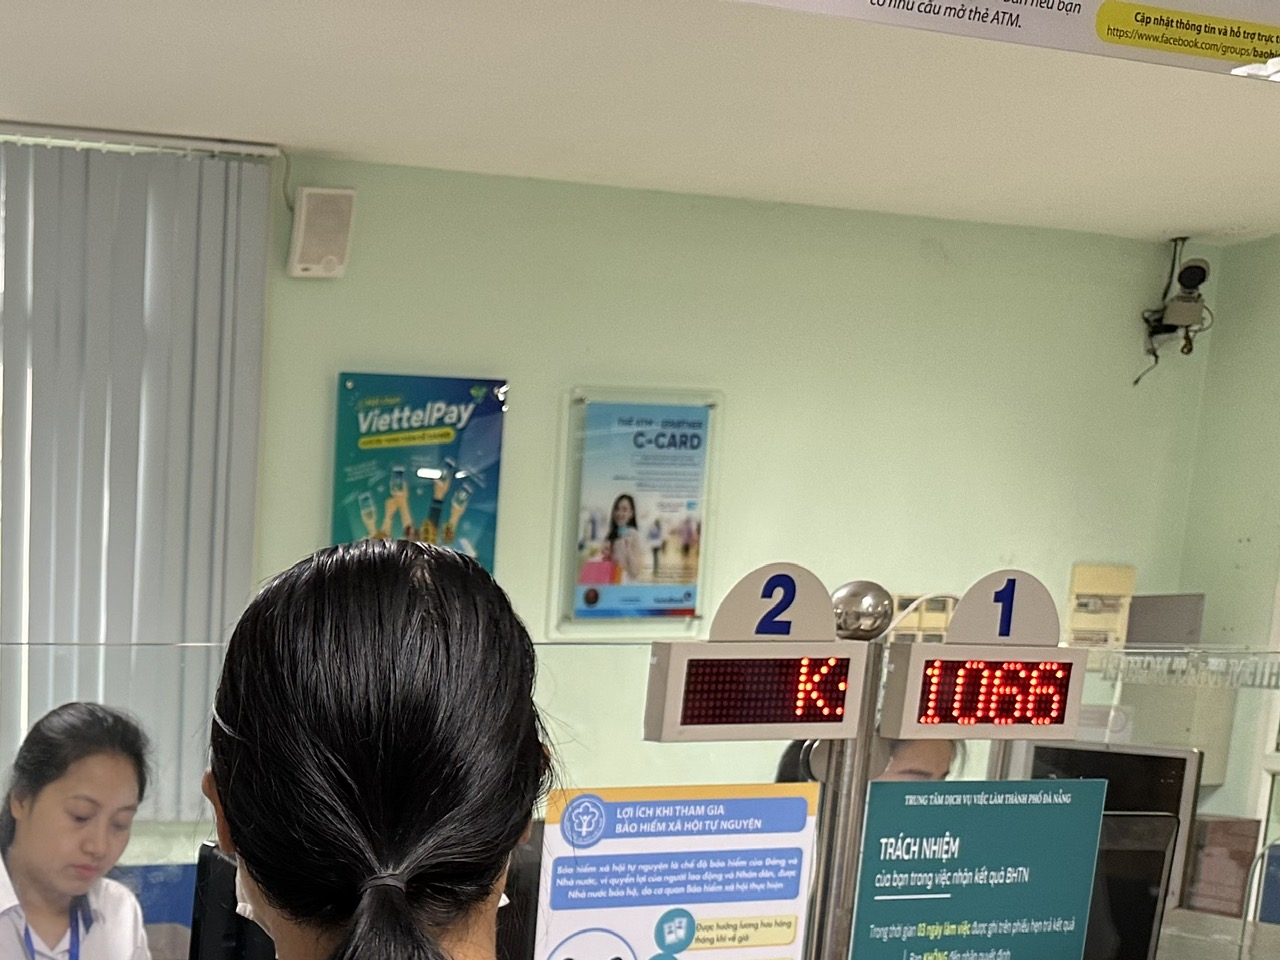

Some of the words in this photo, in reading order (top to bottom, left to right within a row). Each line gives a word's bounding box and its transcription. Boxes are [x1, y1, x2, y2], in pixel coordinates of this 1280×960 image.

[990, 11, 1022, 28] ATM.
[1204, 23, 1216, 34] tin
[1218, 26, 1227, 36] và
[358, 401, 475, 434] ViettelPay
[634, 431, 701, 449] C-CARD
[755, 574, 797, 636] 2
[993, 578, 1017, 637] 1
[920, 660, 1064, 726] 1066
[905, 795, 927, 805] TRUNG
[616, 807, 633, 819] LỢI
[636, 805, 652, 818] ÍCH
[656, 806, 672, 816] KHI
[675, 806, 704, 816] THAM
[707, 805, 724, 815] GIA
[880, 832, 919, 860] TRÁCH
[921, 831, 960, 863] NHIỆM
[875, 869, 891, 887] của
[892, 871, 909, 889] bạn
[911, 871, 933, 889] trong
[935, 869, 951, 887] việc
[1006, 867, 1029, 883] BHTN
